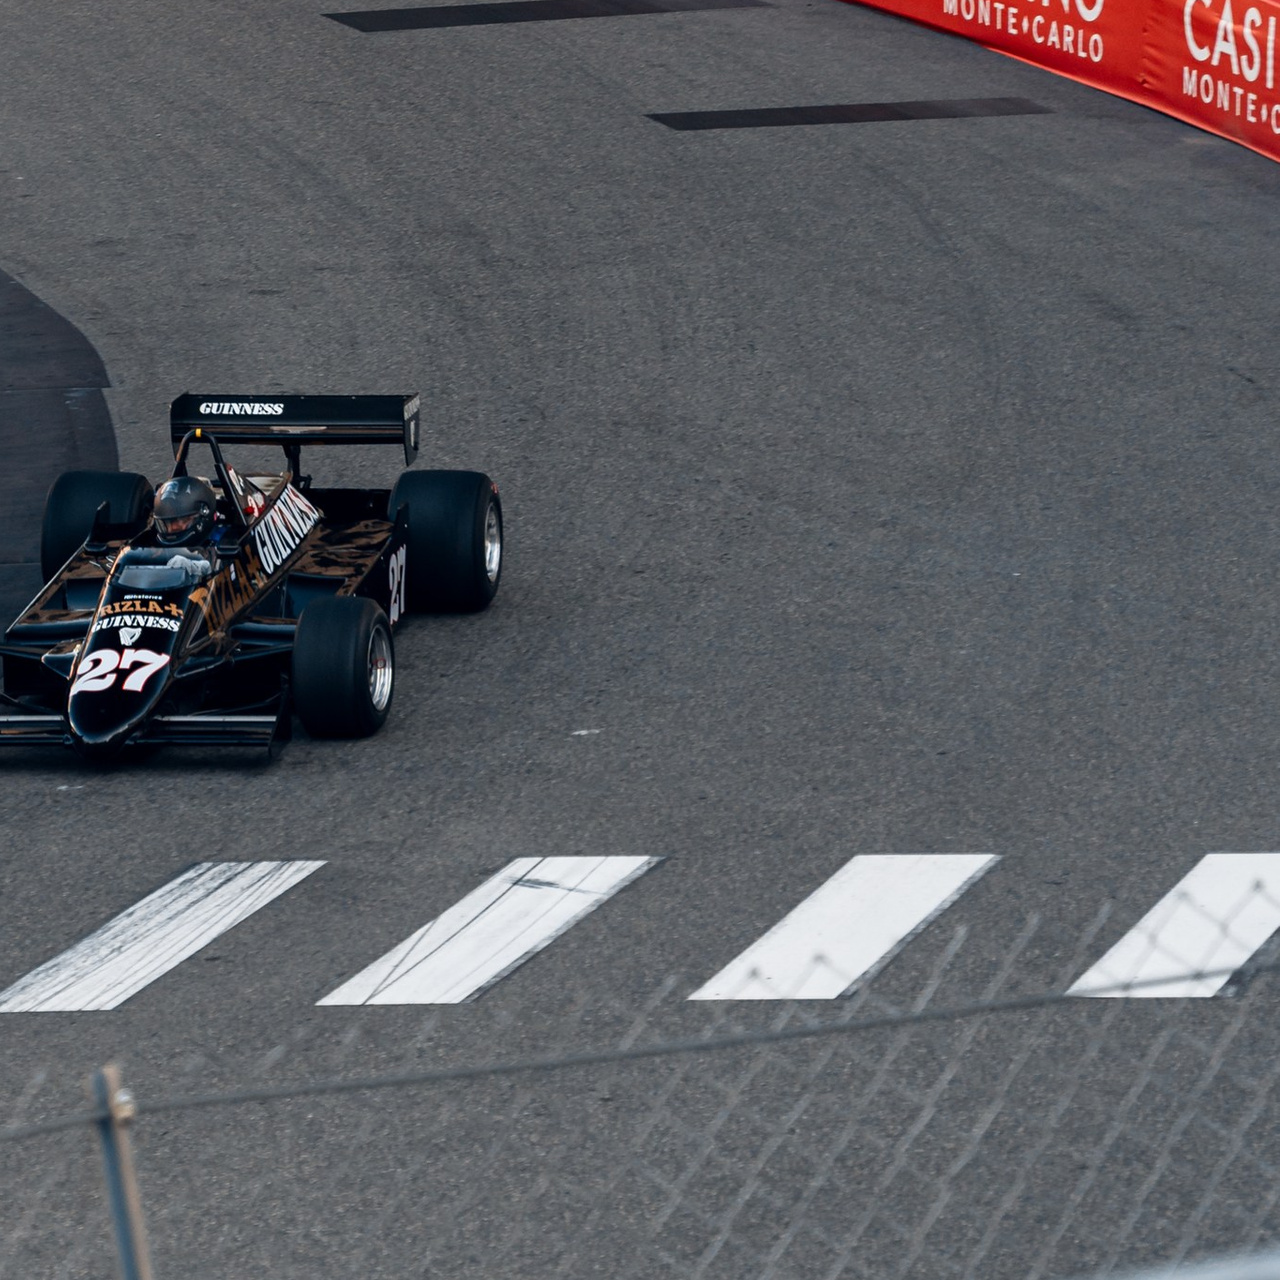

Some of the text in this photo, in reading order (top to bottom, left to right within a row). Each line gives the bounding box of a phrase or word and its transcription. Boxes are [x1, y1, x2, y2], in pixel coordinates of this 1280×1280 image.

[1182, 66, 1258, 124] MONTE
[199, 402, 285, 416] GUINNESS
[388, 543, 407, 626] 27
[91, 613, 181, 633] GUINNESS
[69, 647, 171, 697] 27
